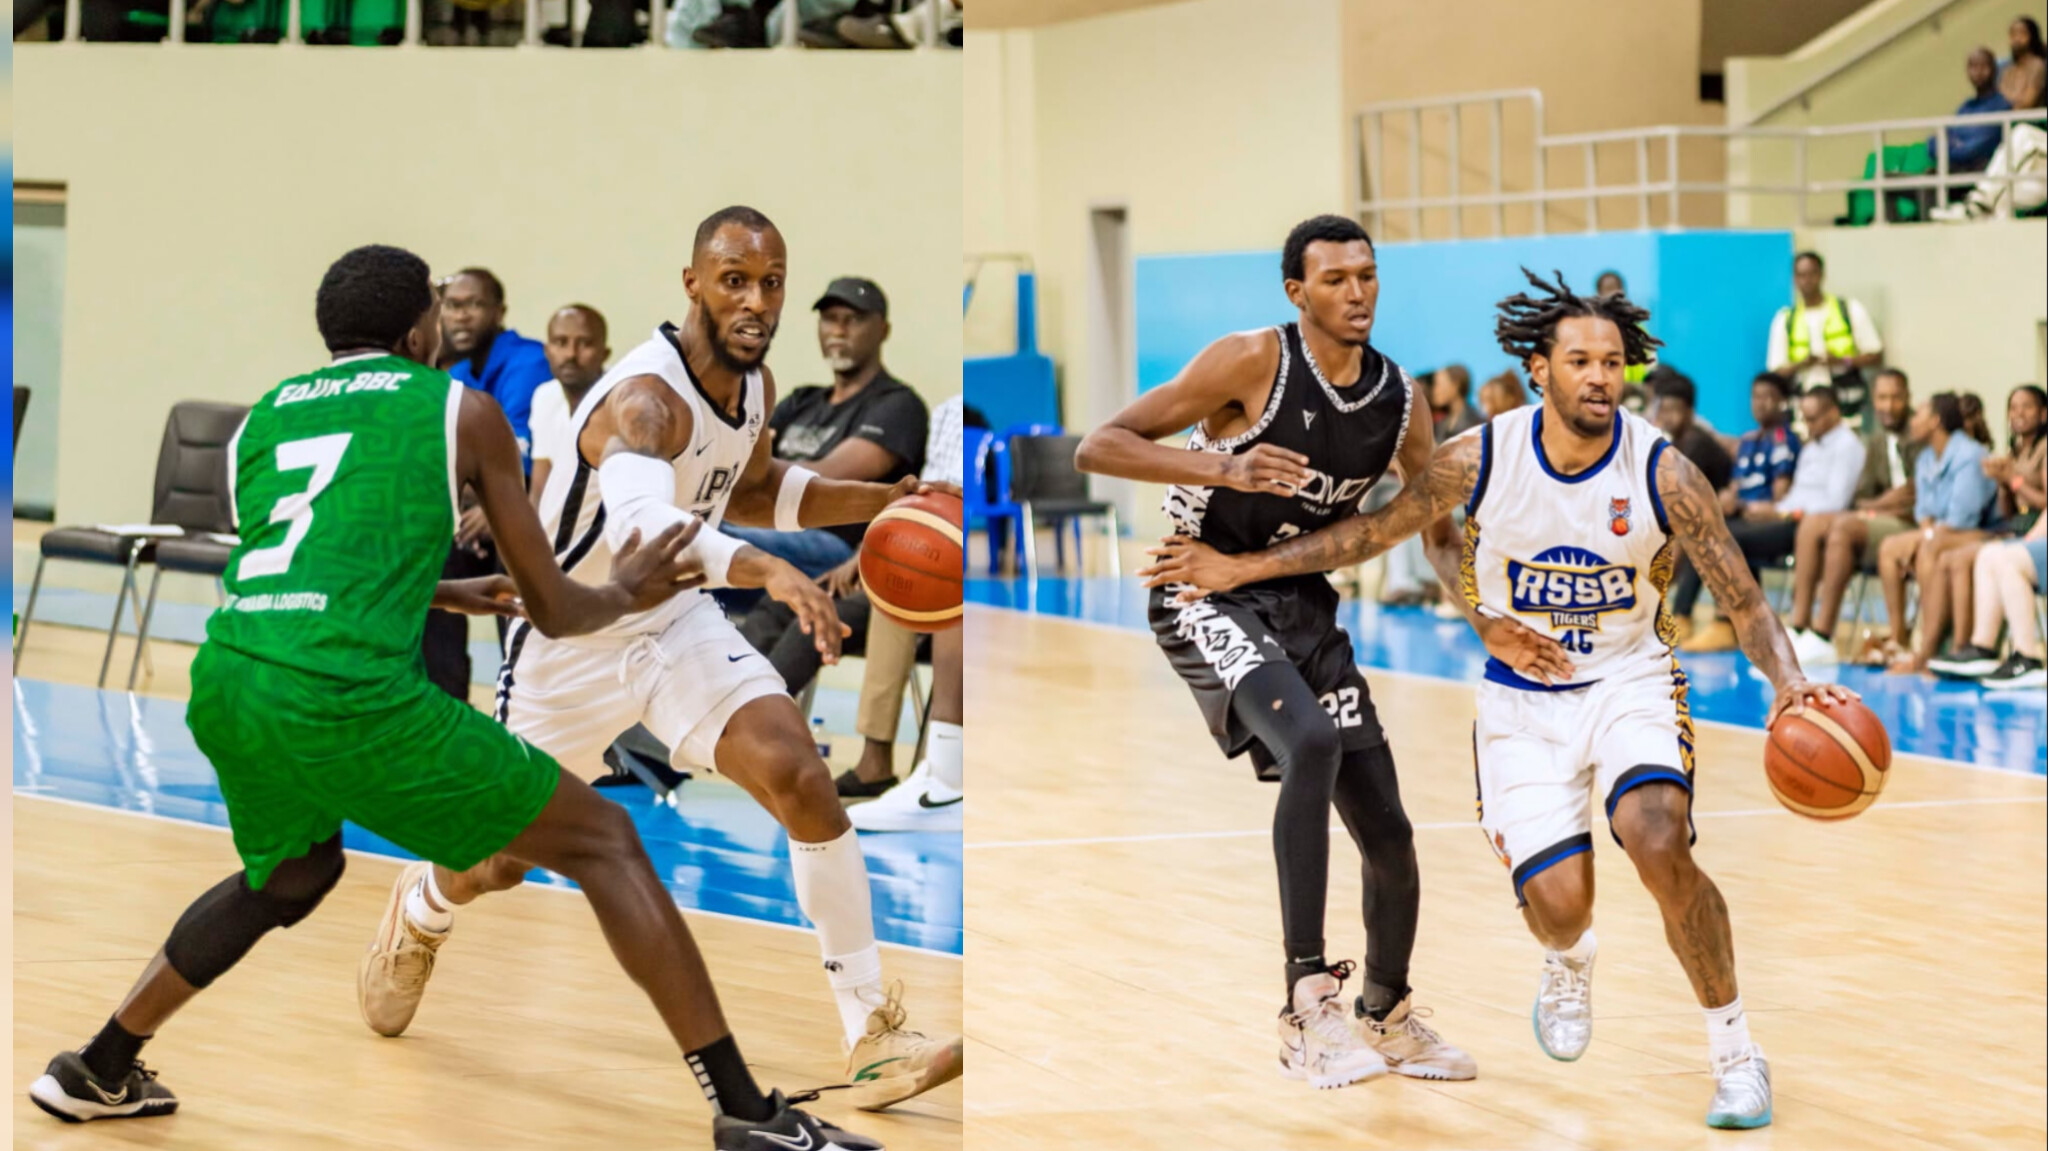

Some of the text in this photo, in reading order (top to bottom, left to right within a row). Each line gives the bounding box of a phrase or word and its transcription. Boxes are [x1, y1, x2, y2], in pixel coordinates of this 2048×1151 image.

[345, 372, 412, 393] BBC
[237, 432, 354, 582] 3
[1514, 564, 1634, 607] RSSB
[1552, 611, 1597, 628] TIGERS
